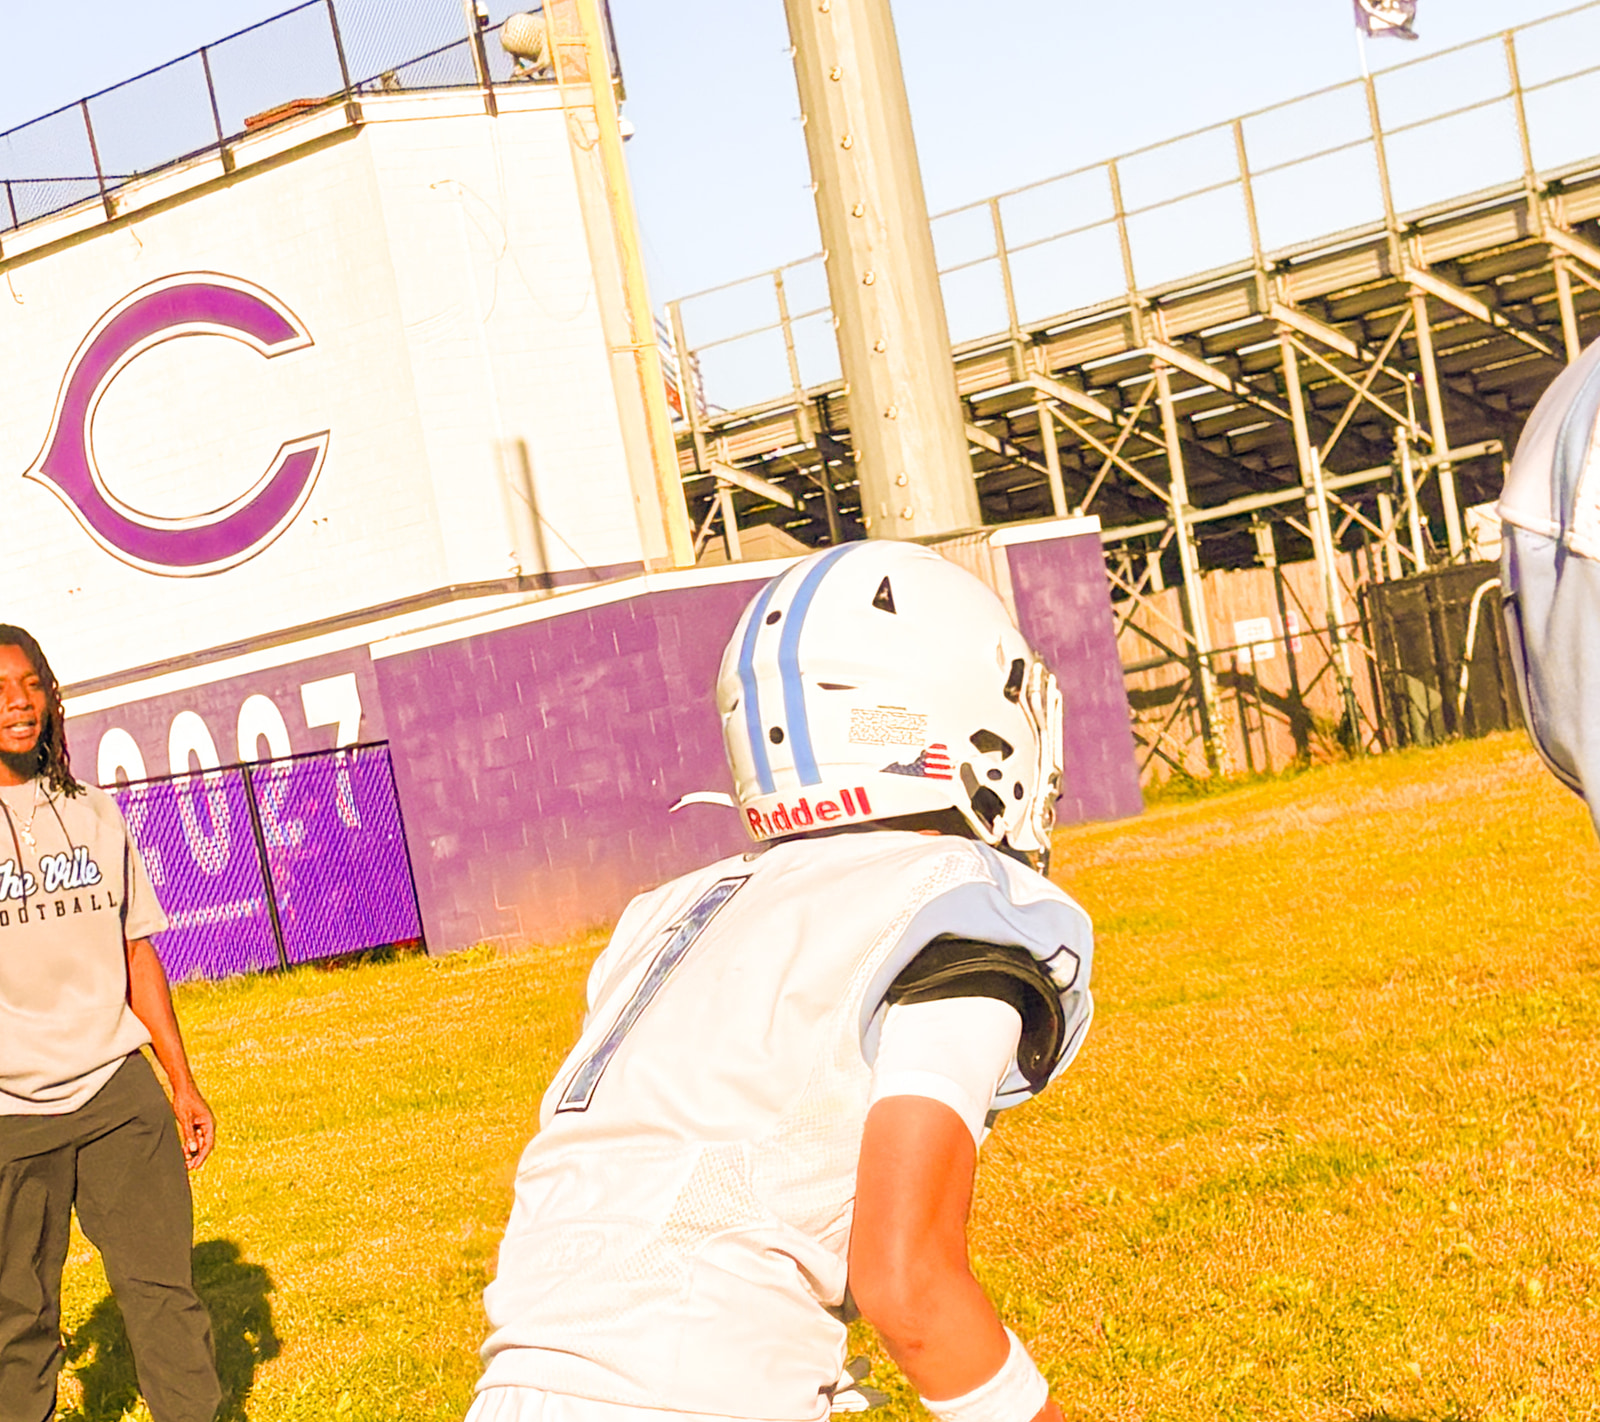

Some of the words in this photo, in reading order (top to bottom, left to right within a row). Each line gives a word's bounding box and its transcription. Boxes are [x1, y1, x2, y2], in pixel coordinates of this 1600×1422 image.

[22, 270, 331, 579] C
[746, 786, 872, 840] Riddell
[0, 858, 39, 902] he
[39, 845, 103, 893] Ville
[0, 890, 118, 927] OOTBALL
